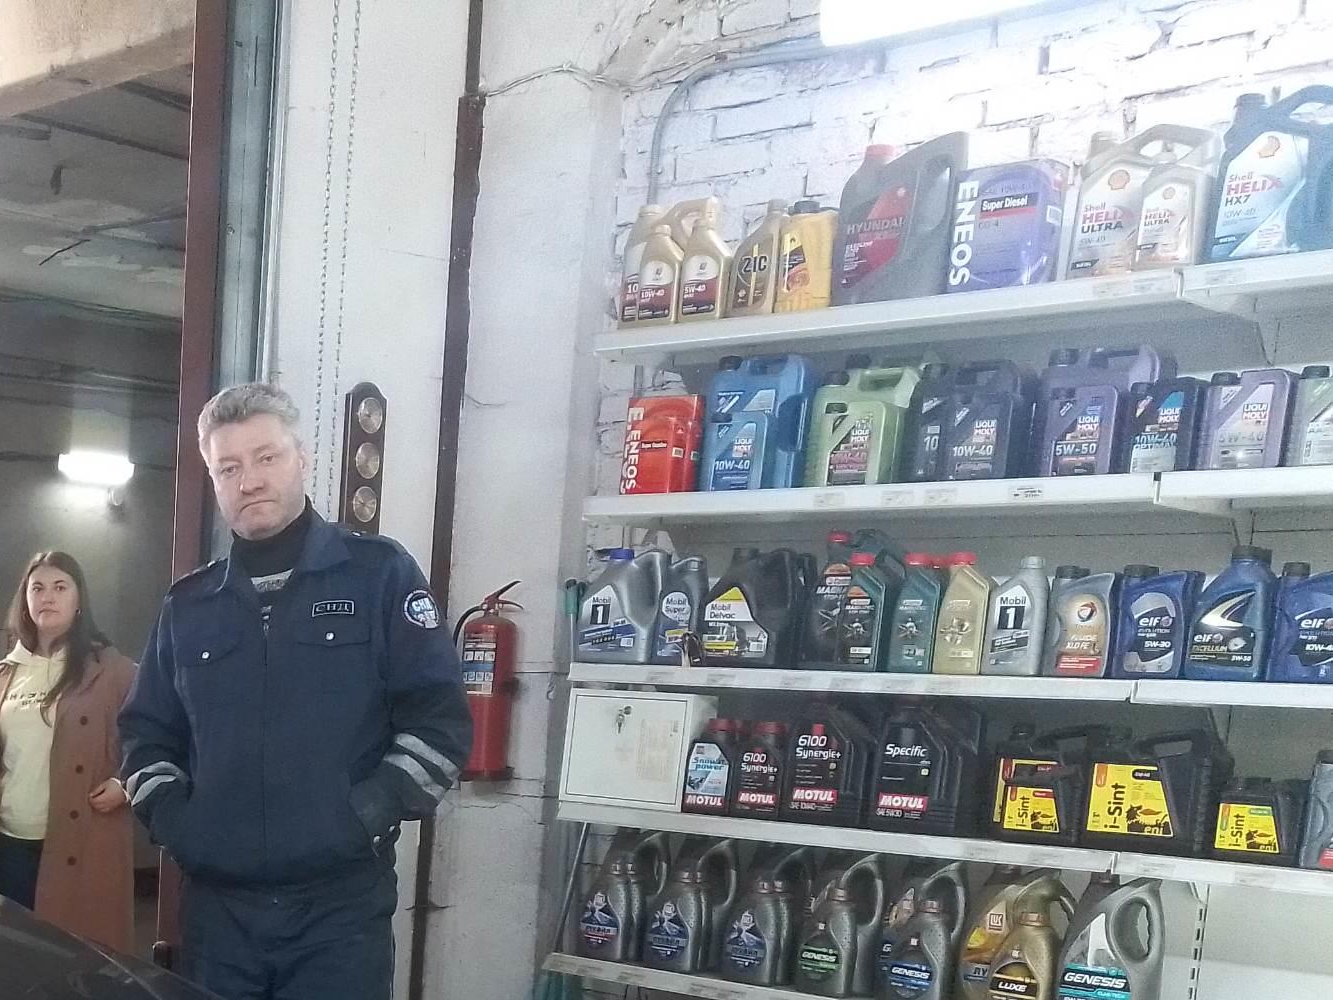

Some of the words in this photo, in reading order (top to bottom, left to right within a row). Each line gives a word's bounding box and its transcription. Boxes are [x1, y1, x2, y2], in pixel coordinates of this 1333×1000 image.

[1228, 171, 1253, 183] Shell
[1227, 177, 1282, 196] HELIX
[982, 200, 1004, 212] Super
[1004, 195, 1028, 208] Diesel
[1225, 194, 1252, 207] HX7
[1085, 202, 1106, 212] Shell
[847, 216, 906, 235] HYUNDAI
[1081, 220, 1124, 234] ULTRA
[949, 180, 979, 286] ENEOS
[742, 255, 768, 273] ZIC
[1160, 407, 1180, 416] LIQUI
[1244, 403, 1268, 412] LIQUI
[1078, 415, 1099, 424] LIQUI
[1158, 415, 1179, 423] MOLY
[1243, 411, 1267, 420] MOLY
[975, 419, 996, 428] LIQUI
[1077, 423, 1099, 432] MOLY
[852, 428, 870, 436] LIQUI
[974, 427, 995, 436] MOLY
[851, 435, 869, 443] MOLY
[953, 444, 993, 457] 10W-40
[1055, 443, 1097, 456] 5W-50
[626, 429, 642, 490] ENEOS
[715, 459, 750, 471] 10W-40
[592, 596, 612, 604] Mobil
[666, 597, 688, 606] Mobil
[1000, 596, 1027, 605] Mobil
[665, 605, 685, 615] Super
[710, 603, 732, 611] Mobil
[595, 605, 604, 624] 1
[709, 611, 736, 620] Delvac
[1006, 607, 1016, 629] 1
[1139, 617, 1161, 627] elf
[1300, 618, 1325, 629] elf
[1194, 633, 1213, 643] elf
[1305, 643, 1333, 651] 10W-4
[798, 735, 827, 747] 6100
[884, 743, 927, 759] Specific
[743, 752, 766, 763] 6100
[686, 794, 723, 806] MOTUL
[739, 792, 775, 804] MOTUL
[793, 789, 835, 802] MOTUL
[879, 795, 924, 809] MOTUL
[1104, 782, 1126, 829] i-Sint
[1144, 824, 1164, 835] eni
[1228, 813, 1246, 847] i-Sint
[802, 951, 836, 964] GENESIS
[892, 966, 930, 980] GENESIS
[1064, 971, 1127, 989] GENESIS
[998, 981, 1027, 993] LUXE
